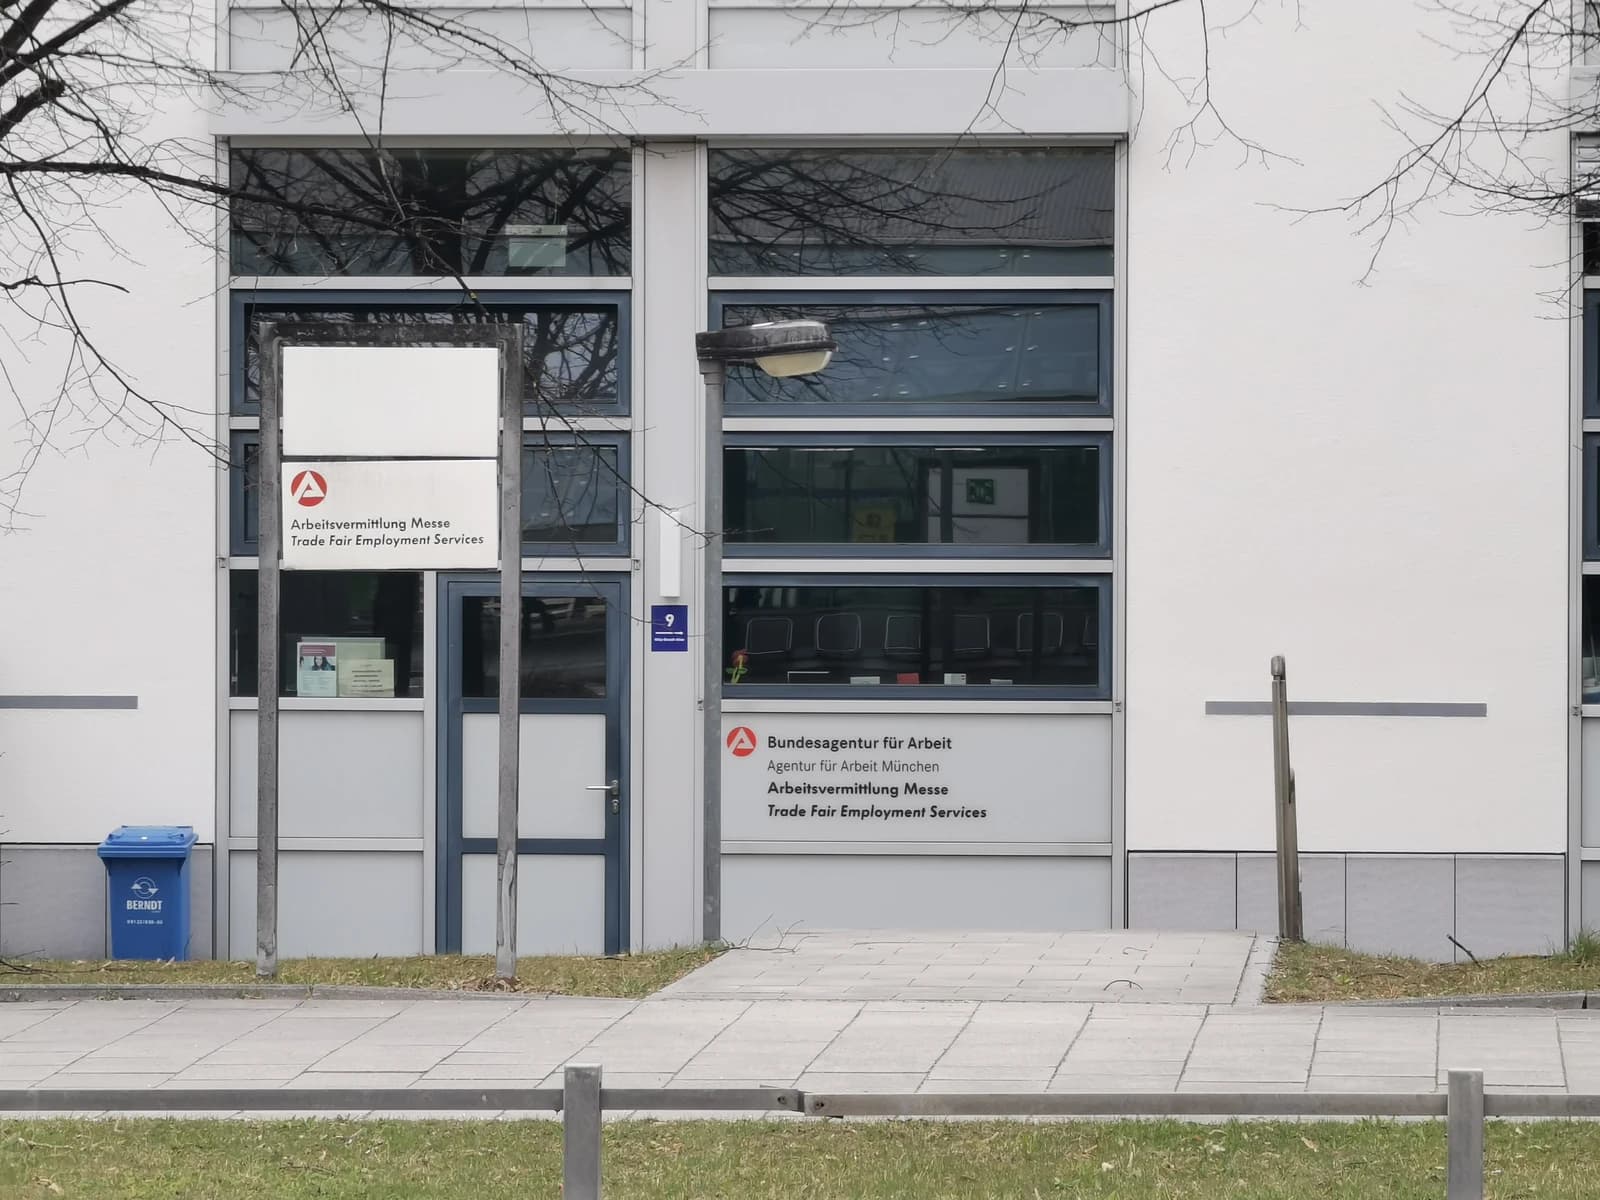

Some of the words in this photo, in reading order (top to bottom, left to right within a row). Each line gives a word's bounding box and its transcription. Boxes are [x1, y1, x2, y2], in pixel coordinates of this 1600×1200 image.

[290, 517, 407, 532] Arbeitsvermittlung
[410, 516, 451, 529] Messe
[290, 534, 326, 547] Trade
[328, 534, 353, 546] Fair
[355, 534, 431, 549] Employment
[433, 533, 485, 545] Services
[665, 613, 675, 628] 9
[767, 735, 880, 753] Bundesagentur
[882, 735, 905, 750] für
[907, 735, 953, 750] Arbeit
[767, 758, 817, 775] Agentur
[819, 759, 838, 773] für
[840, 759, 878, 773] Arbeit
[881, 759, 940, 774] München
[767, 780, 899, 799] Arbeitsvermittlung
[903, 782, 949, 796] Messe
[767, 804, 807, 818] Trade
[810, 804, 837, 819] Fair
[840, 804, 926, 821] Employment
[929, 804, 988, 820] Services
[126, 899, 163, 911] BERNDT
